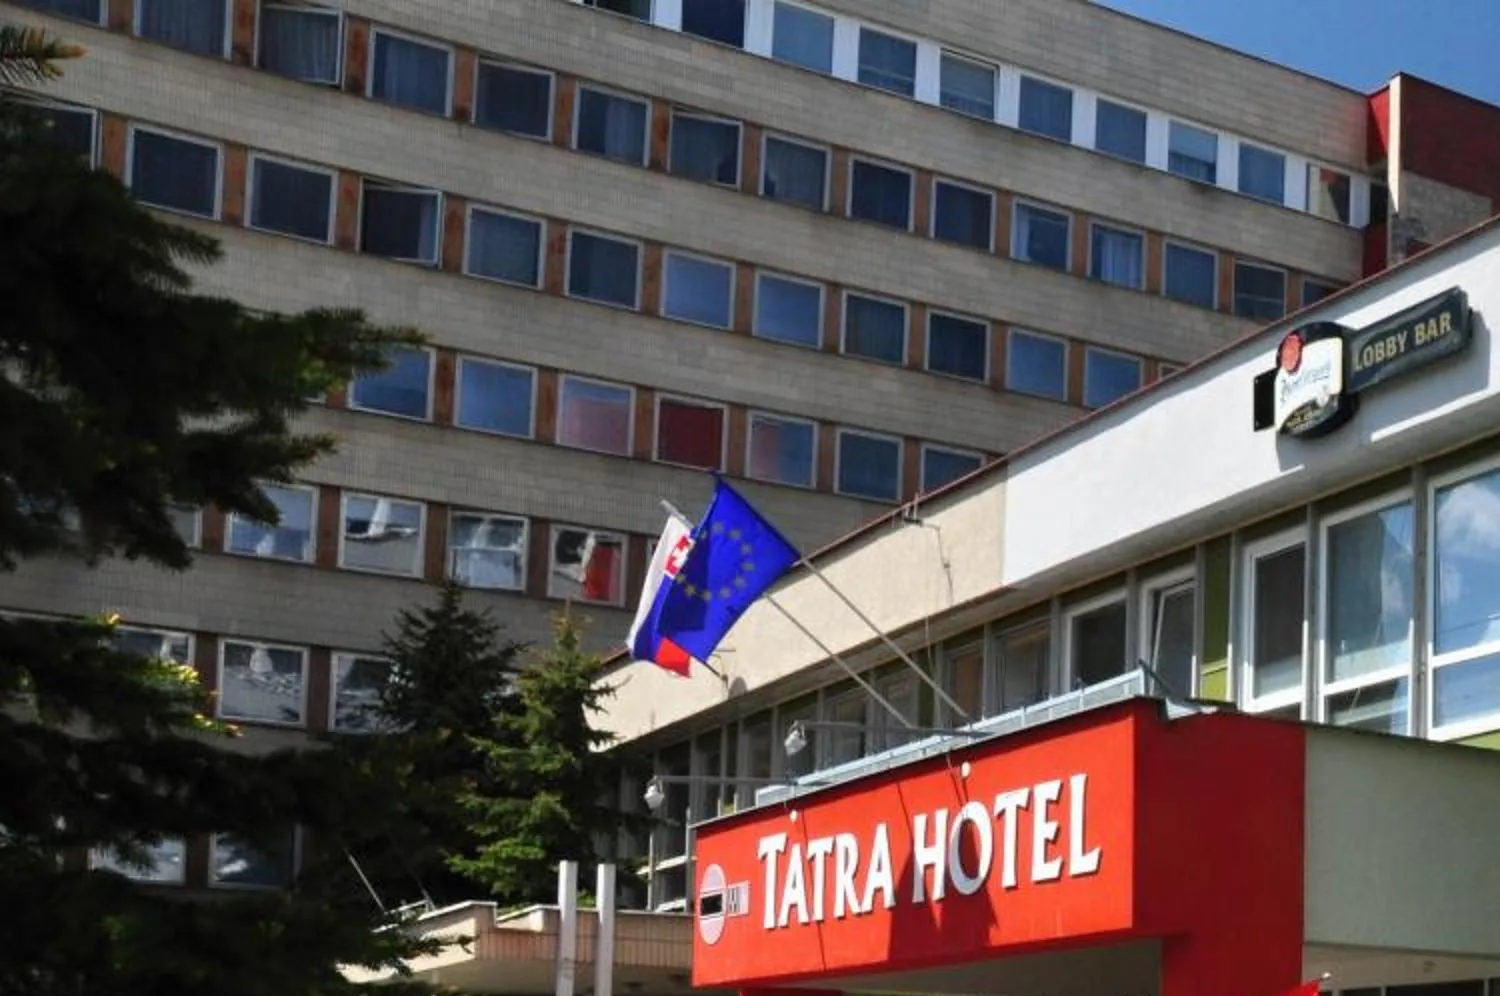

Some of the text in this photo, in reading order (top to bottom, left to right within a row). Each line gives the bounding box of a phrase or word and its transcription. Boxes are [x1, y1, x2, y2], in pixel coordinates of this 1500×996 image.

[1353, 312, 1452, 371] LOBBY BAR
[757, 773, 1101, 929] TATRA HOTEL
